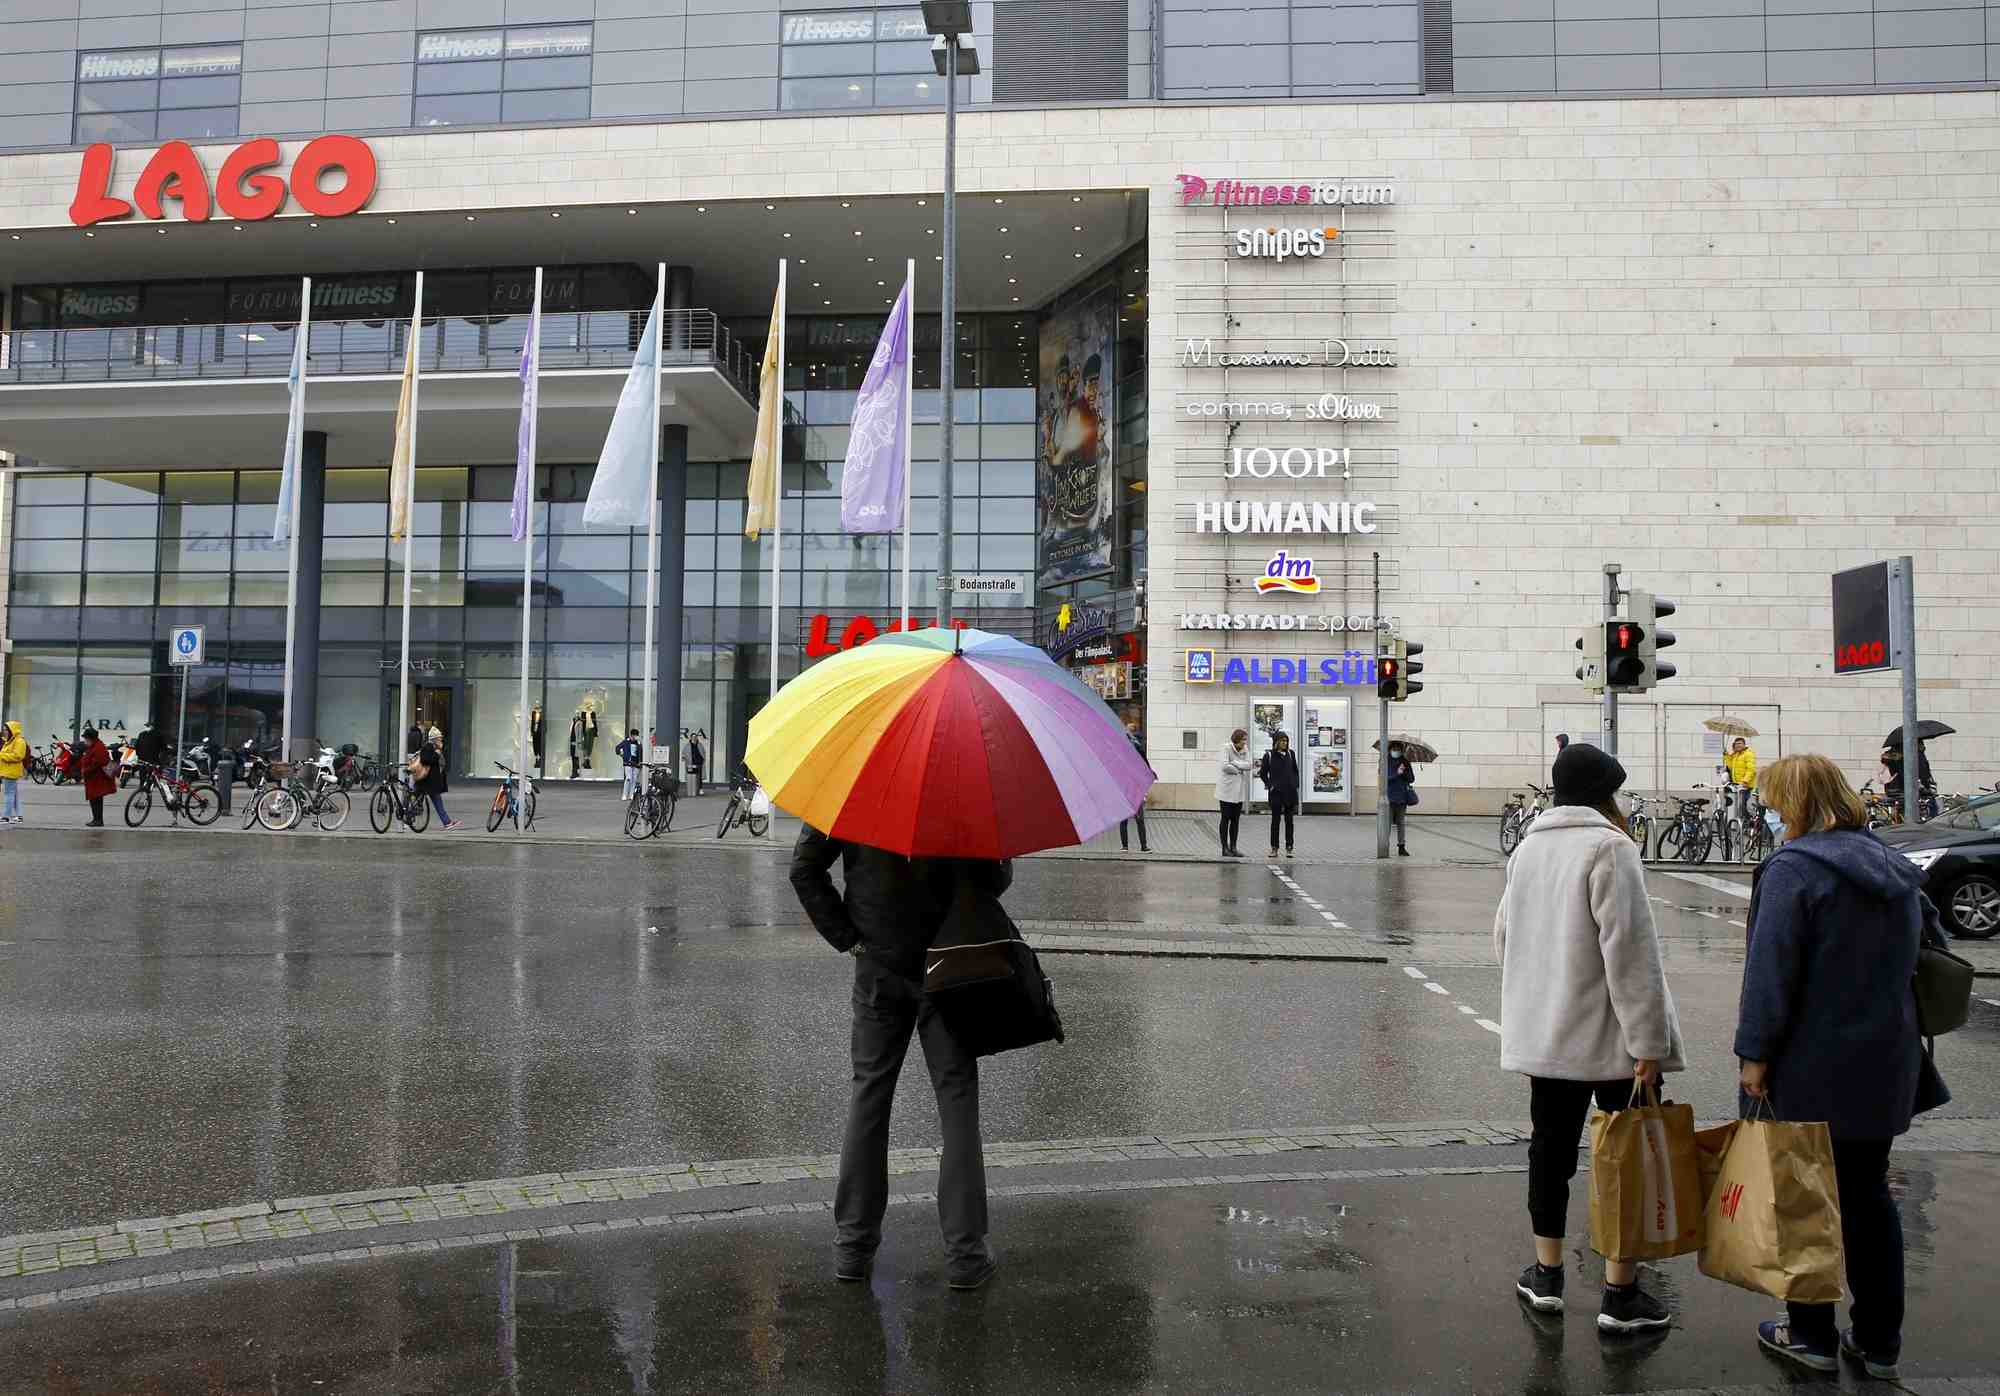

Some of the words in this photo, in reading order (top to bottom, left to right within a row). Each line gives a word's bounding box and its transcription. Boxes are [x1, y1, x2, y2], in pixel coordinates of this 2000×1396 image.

[69, 134, 377, 227] LAGO
[1236, 226, 1326, 262] snipes
[312, 284, 397, 307] fitness
[1181, 338, 1312, 367] Massimo
[1321, 337, 1396, 368] Dutti
[1223, 447, 1351, 479] JOOP!
[1195, 501, 1377, 534] HUMANIC
[1267, 551, 1312, 578] dm
[960, 578, 1016, 590] Bodanstraße
[1180, 614, 1309, 631] KARSTADT
[1317, 614, 1393, 636] spors
[1837, 640, 1885, 667] LAGO
[1223, 657, 1308, 685] ALDI
